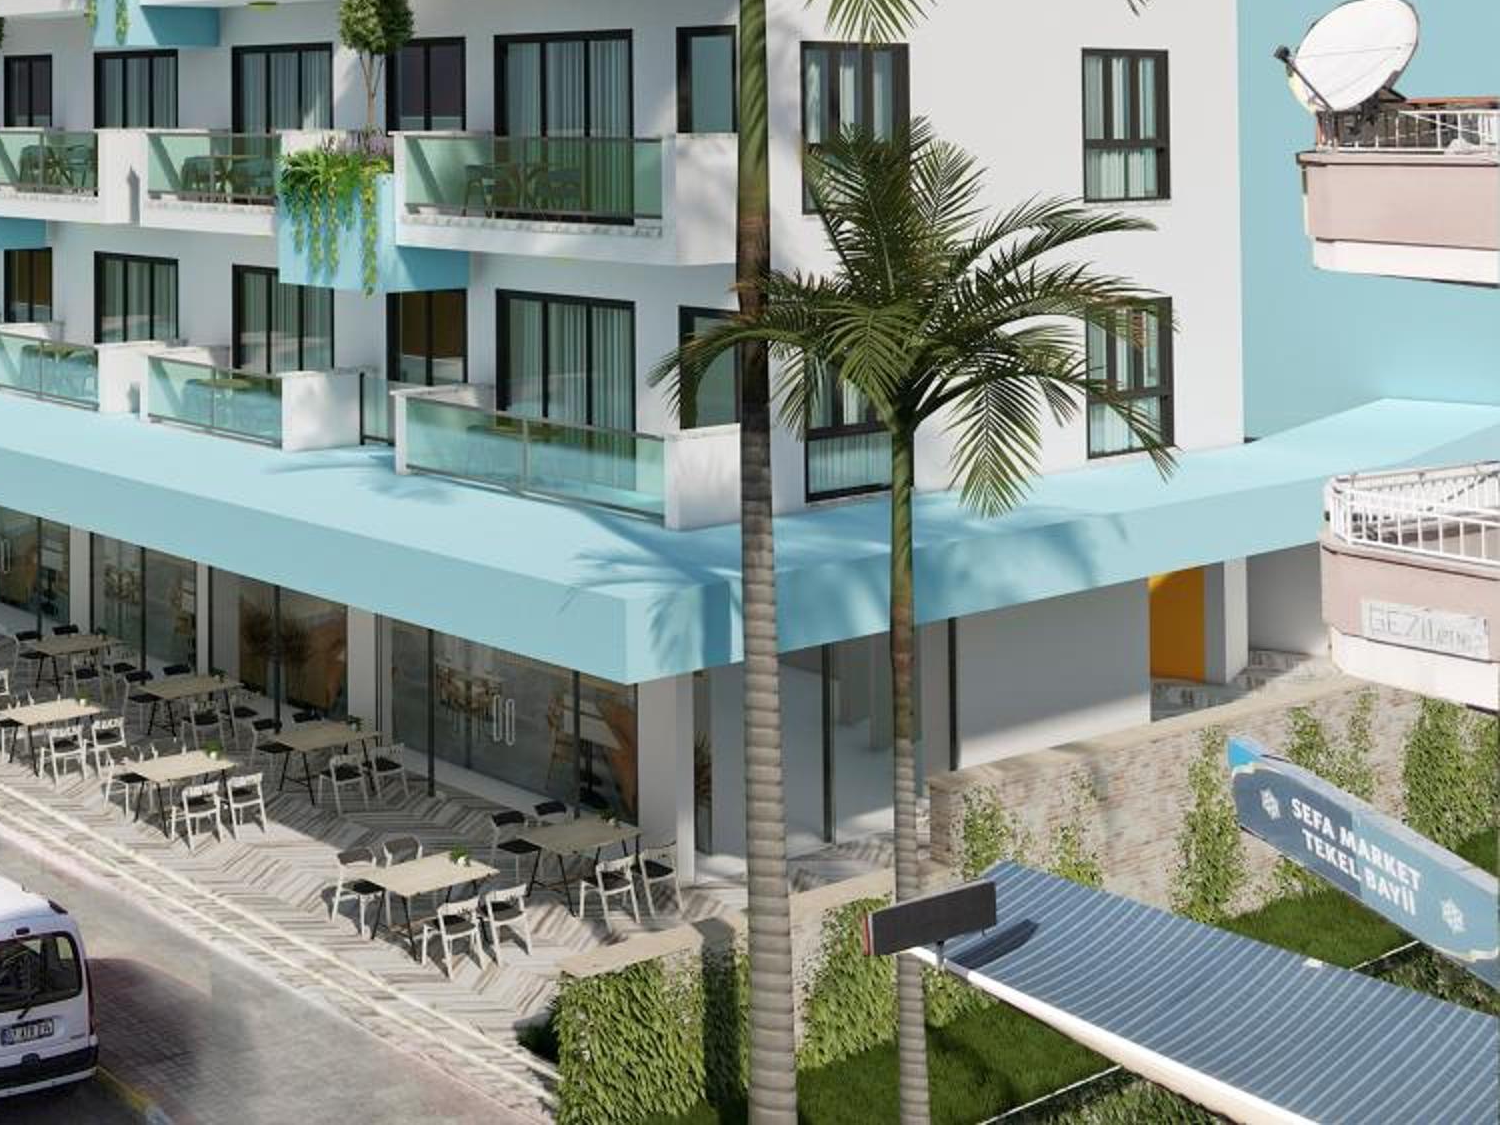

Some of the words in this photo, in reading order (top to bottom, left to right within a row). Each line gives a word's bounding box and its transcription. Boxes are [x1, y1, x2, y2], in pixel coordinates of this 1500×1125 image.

[1291, 797, 1335, 841] SEFA
[1340, 826, 1420, 891] MARKET
[1302, 828, 1361, 882] TEKEL
